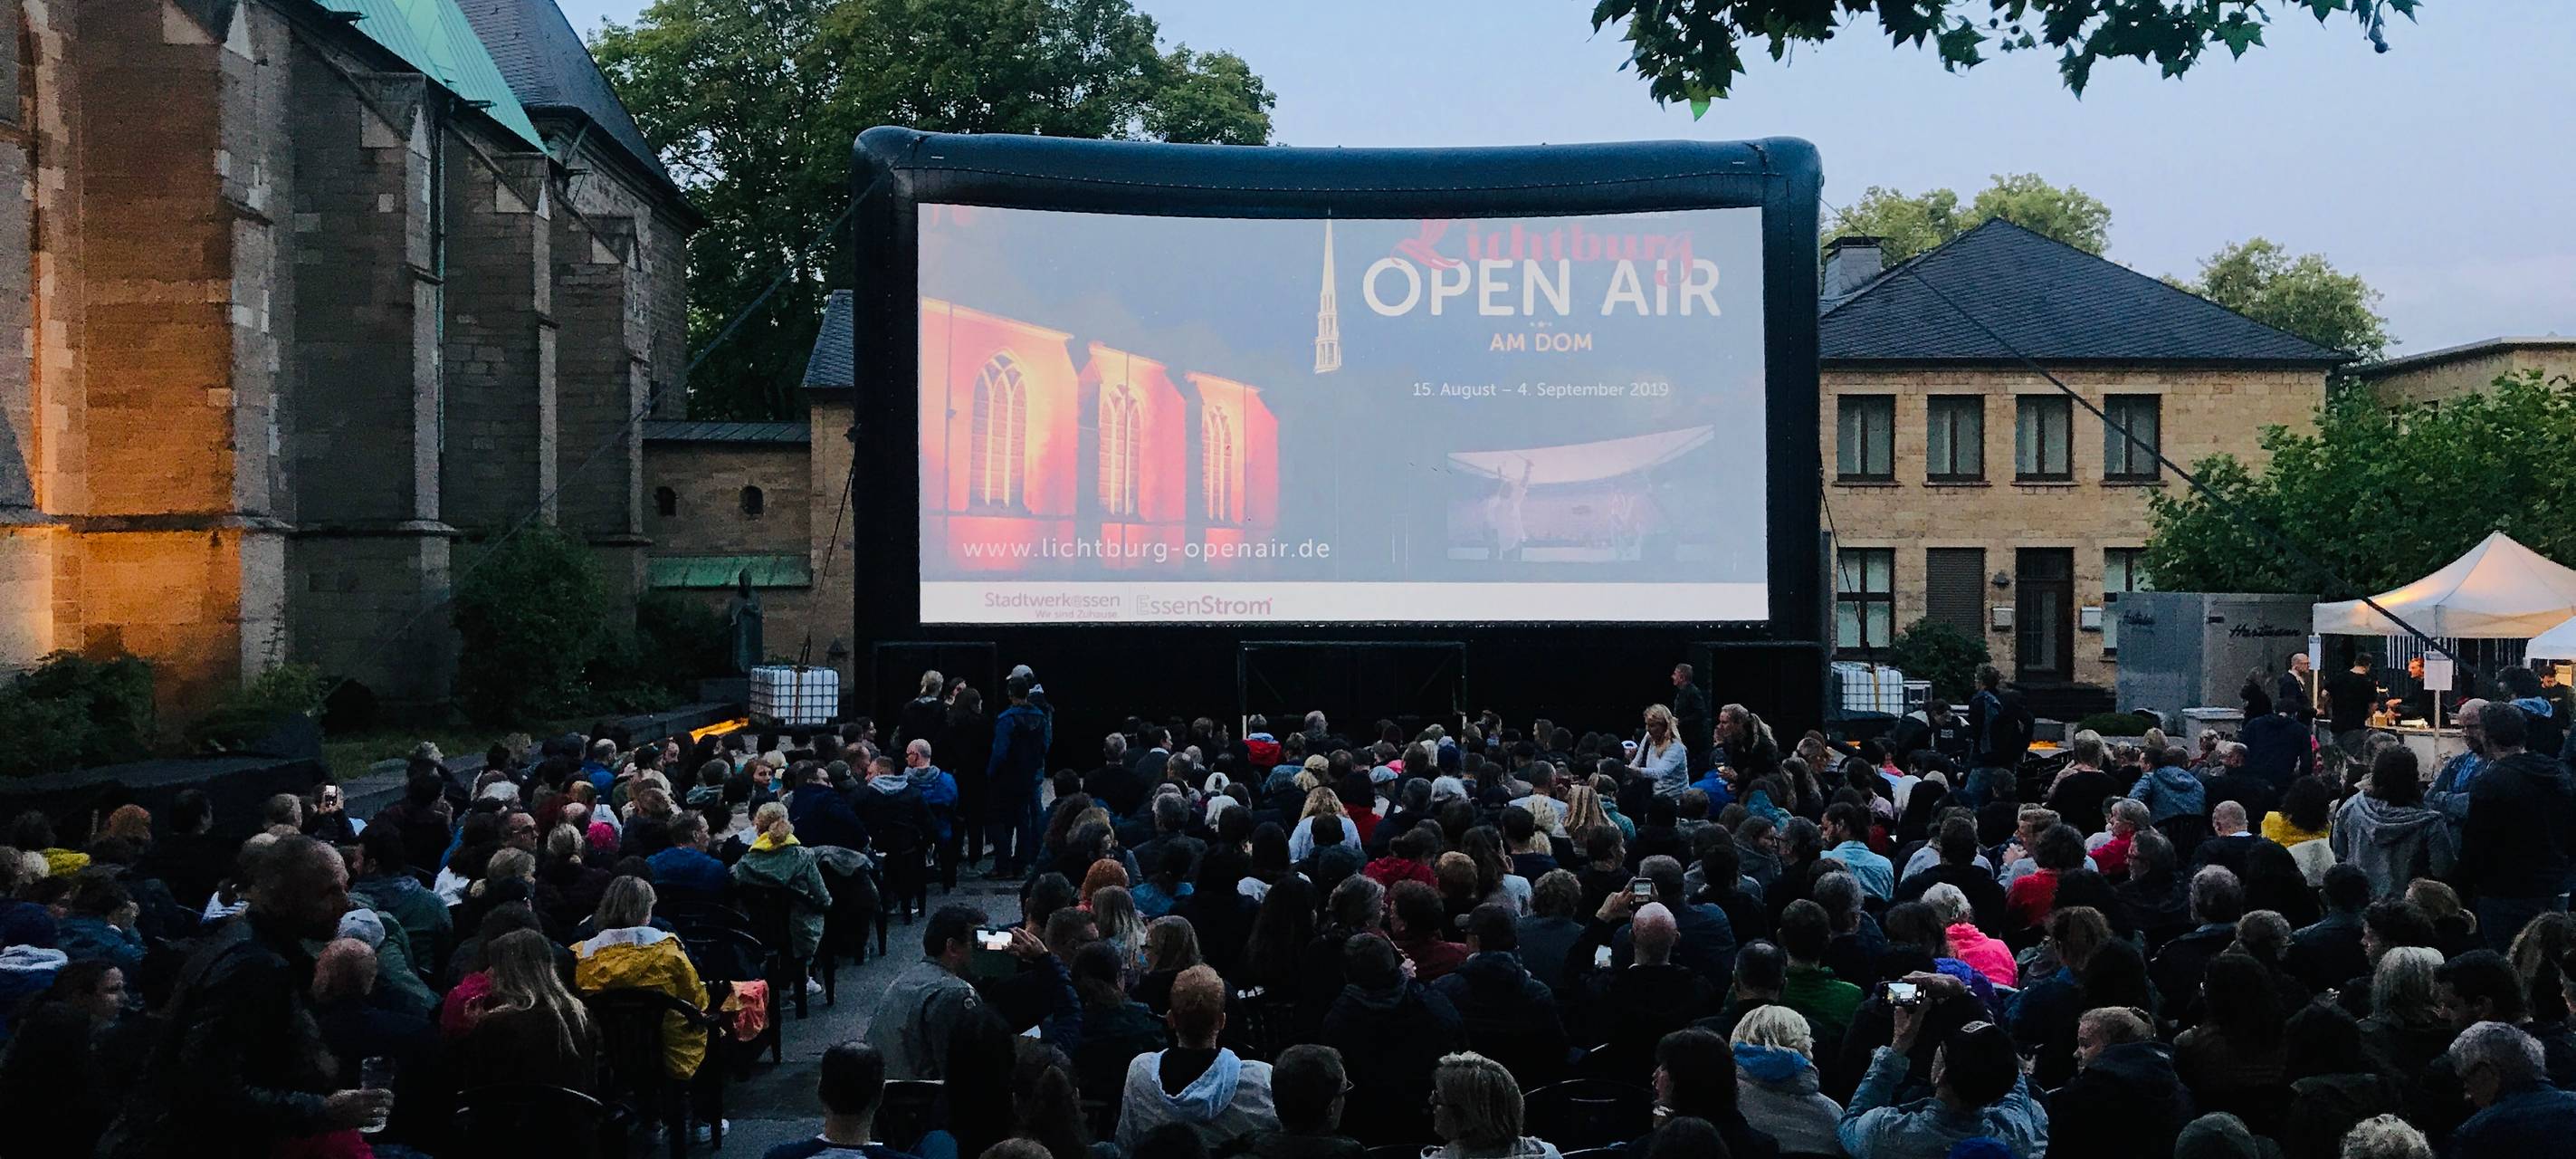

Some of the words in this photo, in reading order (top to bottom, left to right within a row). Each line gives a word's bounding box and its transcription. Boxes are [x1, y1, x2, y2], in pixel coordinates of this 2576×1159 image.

[1362, 257, 1570, 317] OPEN
[1600, 257, 1722, 317] AIR
[1490, 333, 1526, 351] AM
[1536, 332, 1593, 352] DOM
[1412, 382, 1436, 397] 15.
[1440, 382, 1496, 399] August
[1517, 382, 1531, 397] 4.
[1537, 382, 1625, 399] September
[1629, 382, 1669, 397] 2019
[963, 538, 1331, 563] www.lichtburg-openair.de
[1136, 595, 1274, 616] EssenStrom
